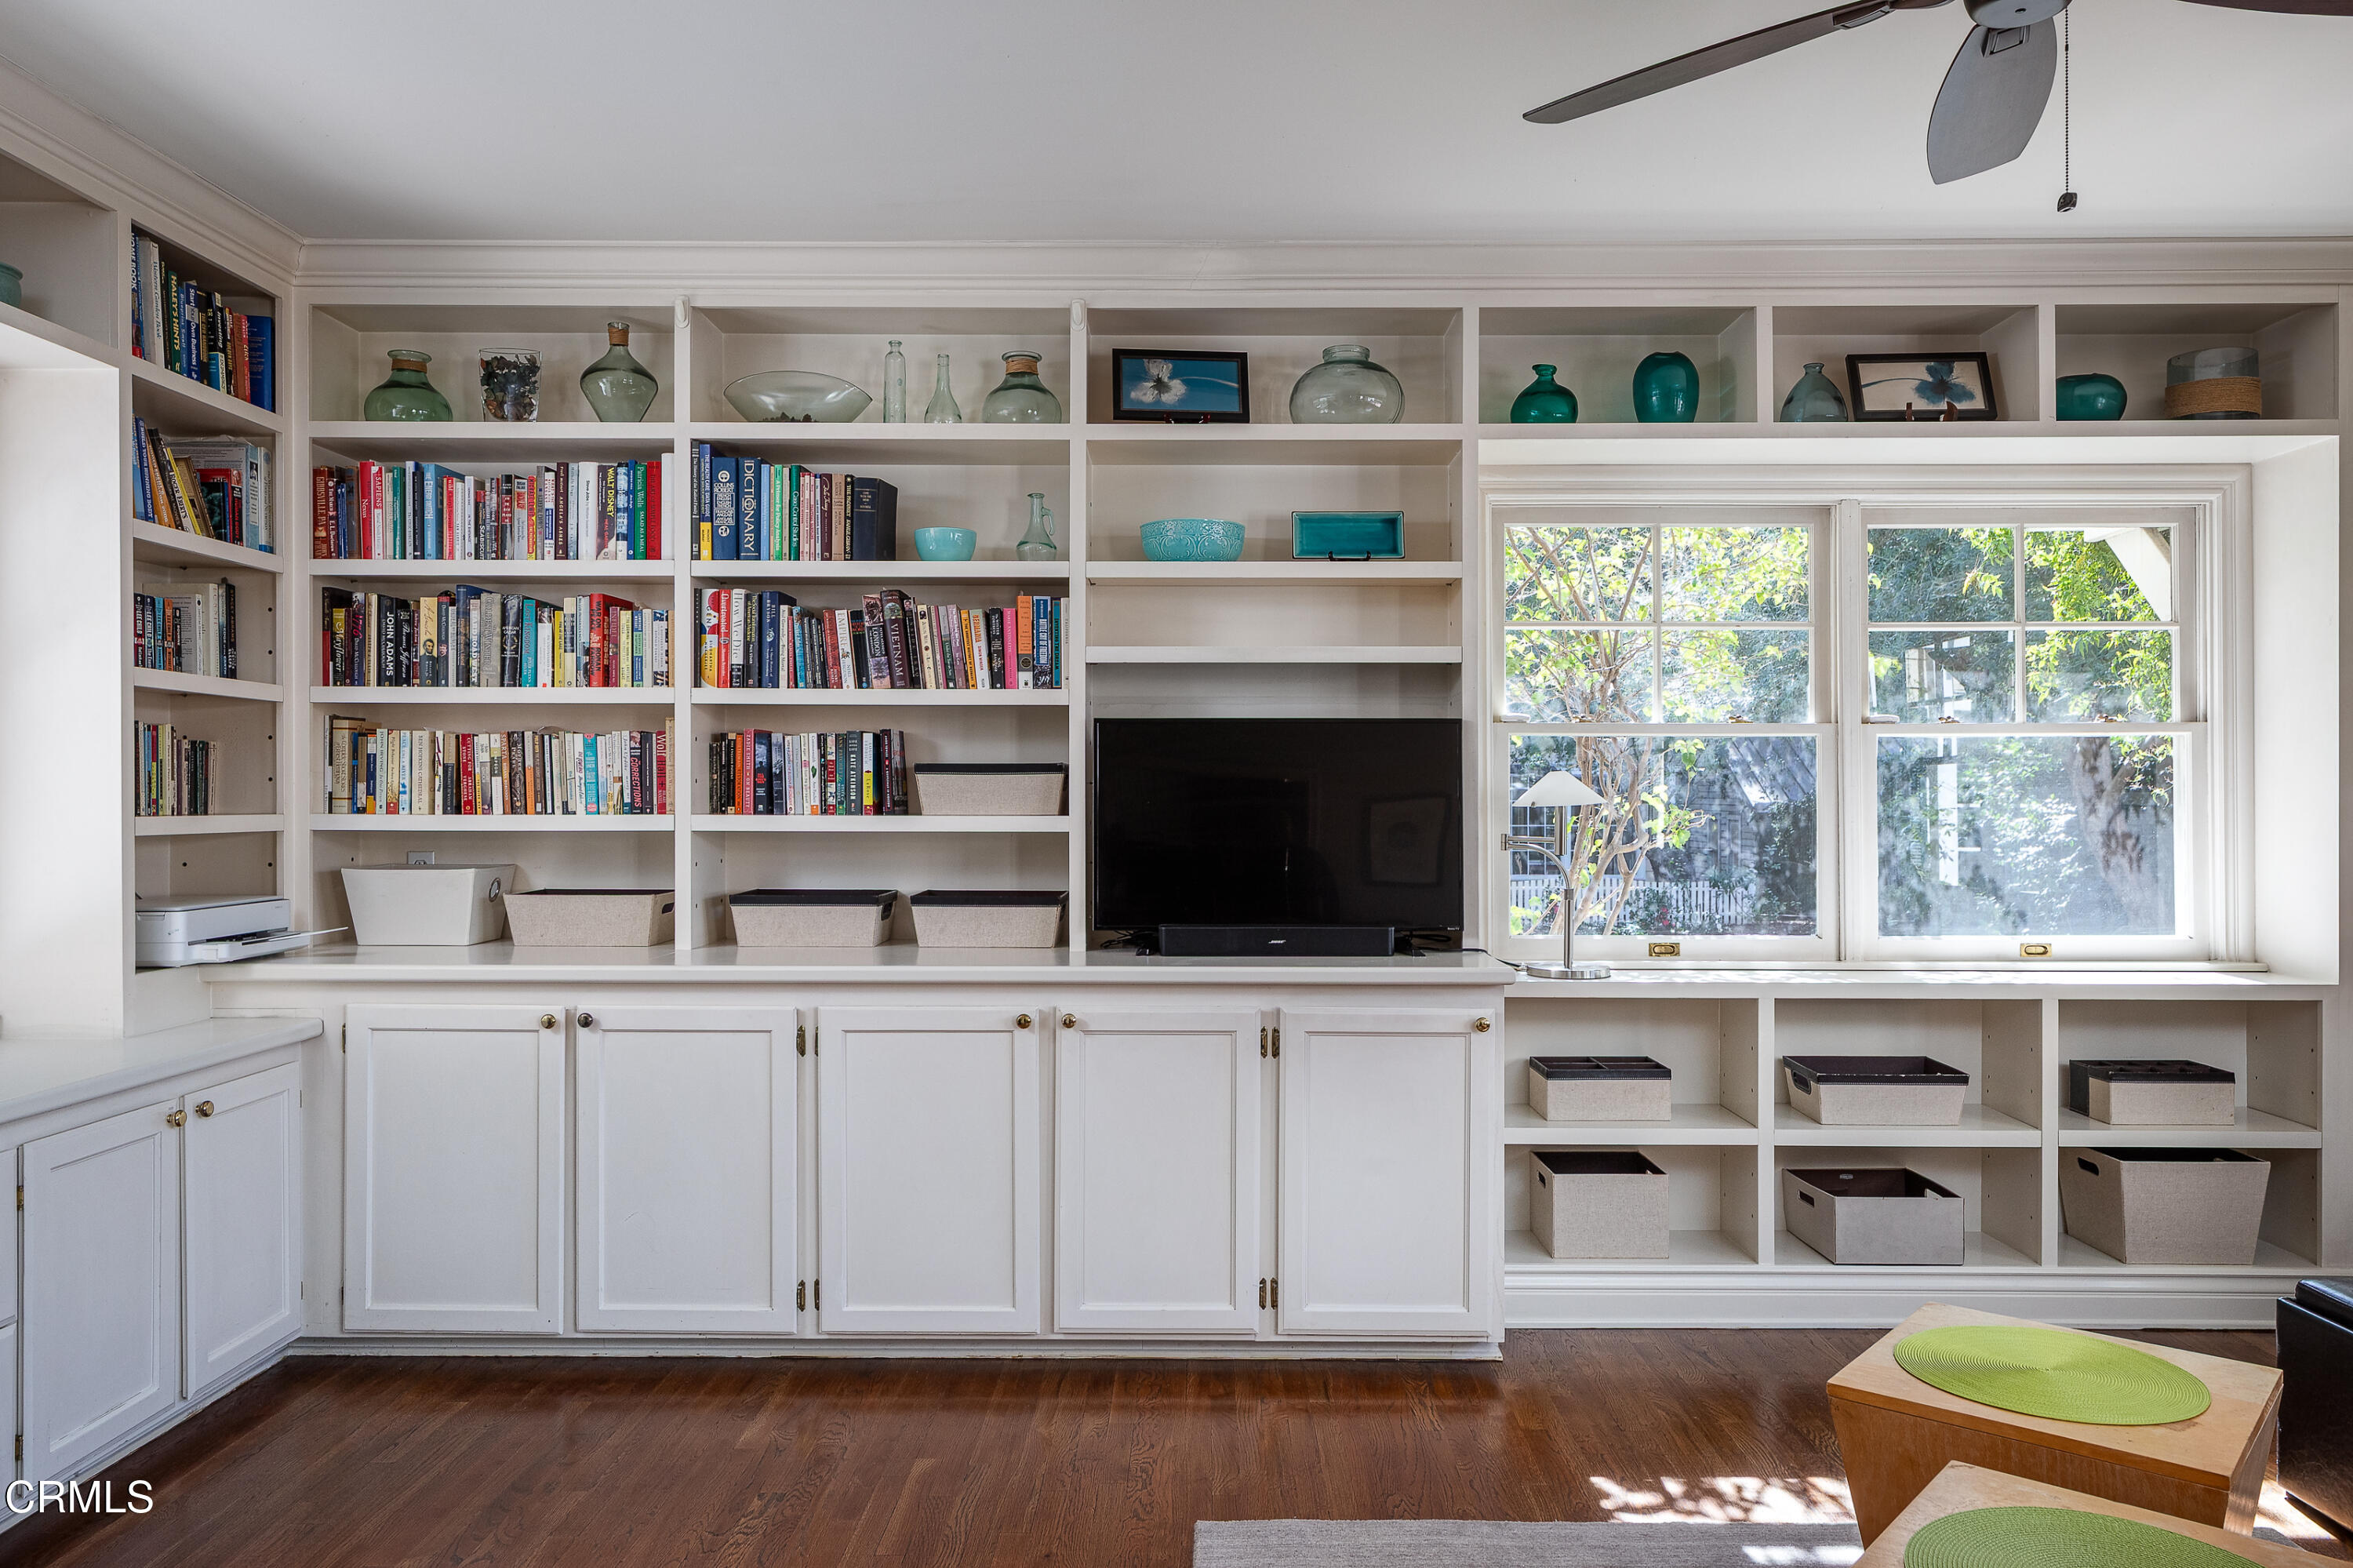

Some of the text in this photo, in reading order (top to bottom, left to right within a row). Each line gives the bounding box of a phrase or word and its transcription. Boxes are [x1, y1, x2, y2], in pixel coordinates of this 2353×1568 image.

[744, 463, 755, 551] DICTIONARY
[352, 615, 364, 639] 1776
[524, 603, 533, 653] LOST KINGDOM
[596, 619, 602, 628] ON
[733, 593, 743, 658] How We Die
[837, 613, 847, 647] EMPIRE
[872, 628, 881, 657] LONDON
[973, 615, 982, 642] GERMANIA
[333, 622, 344, 671] Mayflower
[400, 647, 409, 678] Jefferson
[483, 633, 493, 665] WINTER
[890, 624, 904, 676] VIETNAM
[657, 734, 666, 777] Wolf Hall
[631, 758, 642, 808] CORRECTIONS
